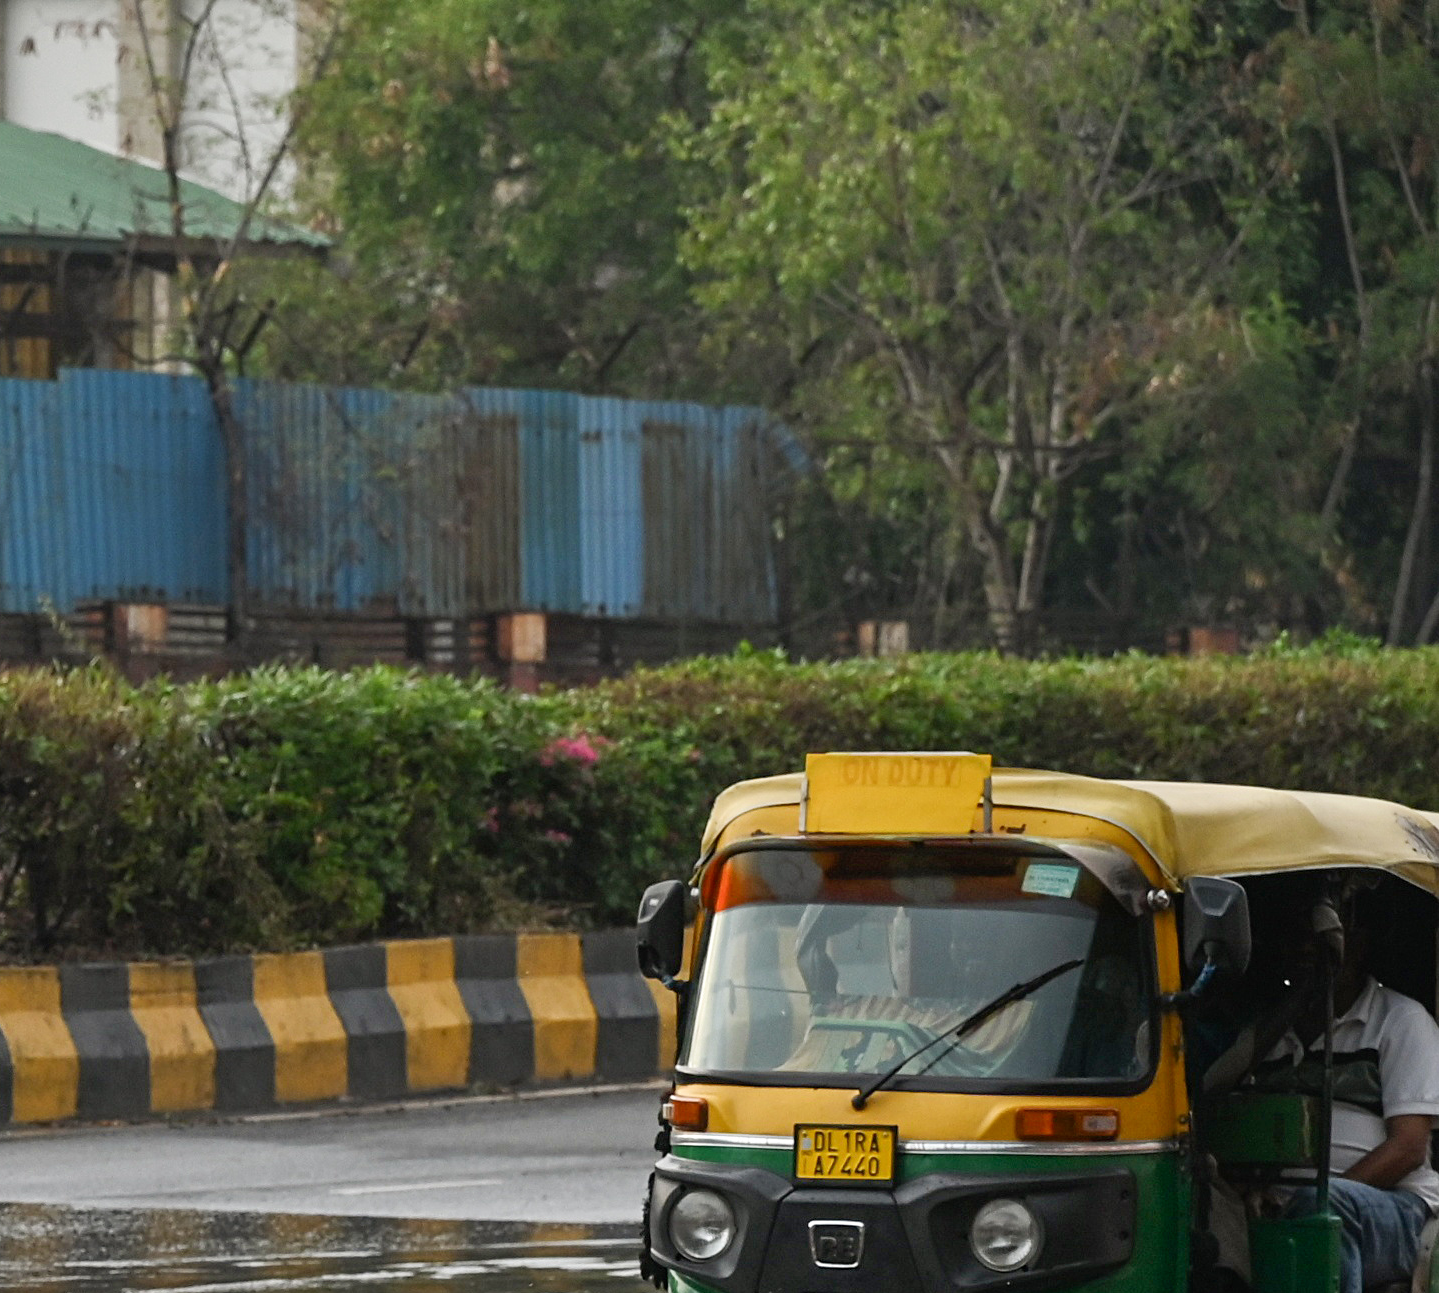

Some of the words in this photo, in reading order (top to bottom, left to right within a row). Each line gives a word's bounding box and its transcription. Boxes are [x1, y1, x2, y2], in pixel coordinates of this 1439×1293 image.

[842, 758, 879, 785] ON
[888, 757, 959, 786] DUTY
[814, 1131, 838, 1152] DL
[844, 1132, 880, 1153] 1RA
[814, 1155, 880, 1177] A7440
